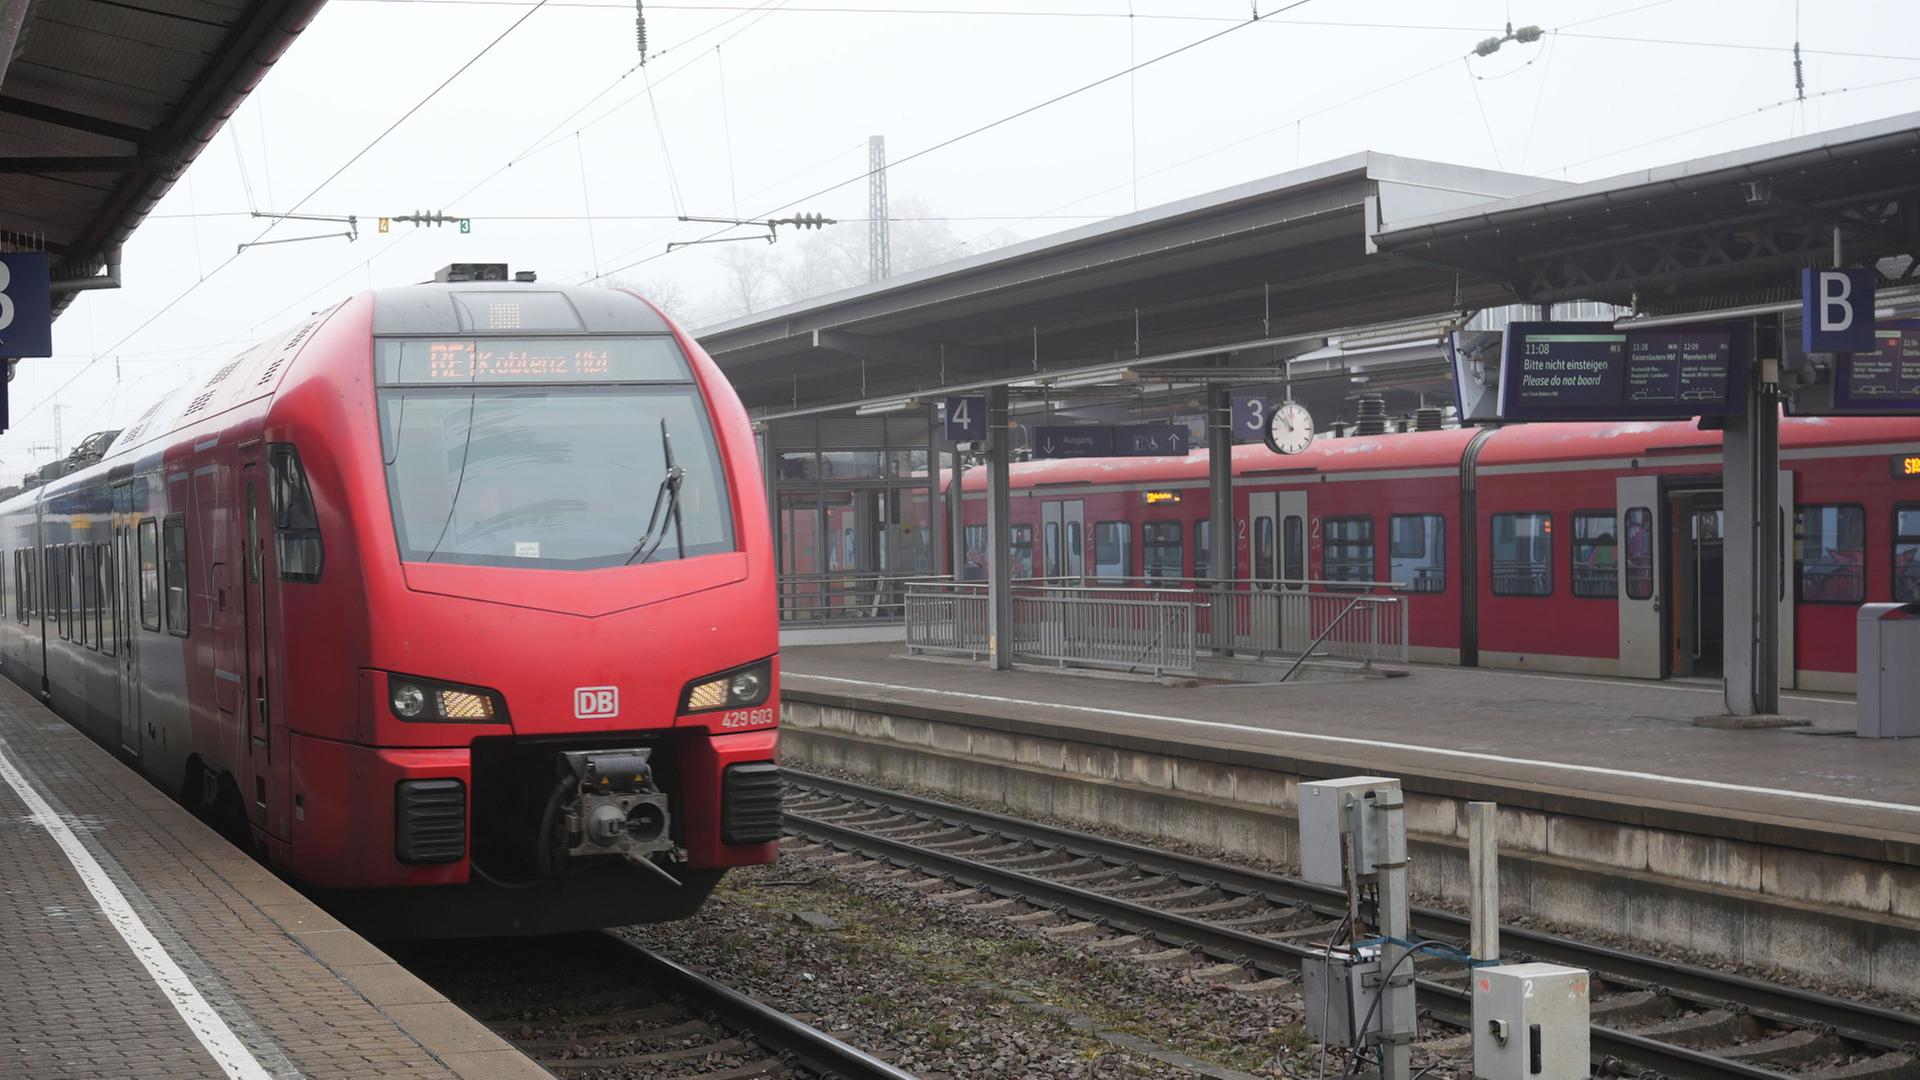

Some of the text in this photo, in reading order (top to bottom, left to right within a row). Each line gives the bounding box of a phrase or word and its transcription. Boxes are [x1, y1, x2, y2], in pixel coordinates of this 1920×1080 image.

[461, 220, 469, 232] 3
[1819, 271, 1854, 332] B
[1525, 343, 1550, 354] 11:08
[1524, 358, 1609, 372] Bitte nicht einsteigen
[1522, 374, 1602, 386] Please do not board
[951, 399, 972, 431] 4
[1246, 399, 1264, 431] 3
[1238, 519, 1246, 539] 2
[1311, 518, 1320, 539] 2
[579, 690, 614, 714] DB
[721, 708, 773, 728] 429 603
[1524, 978, 1534, 998] 2
